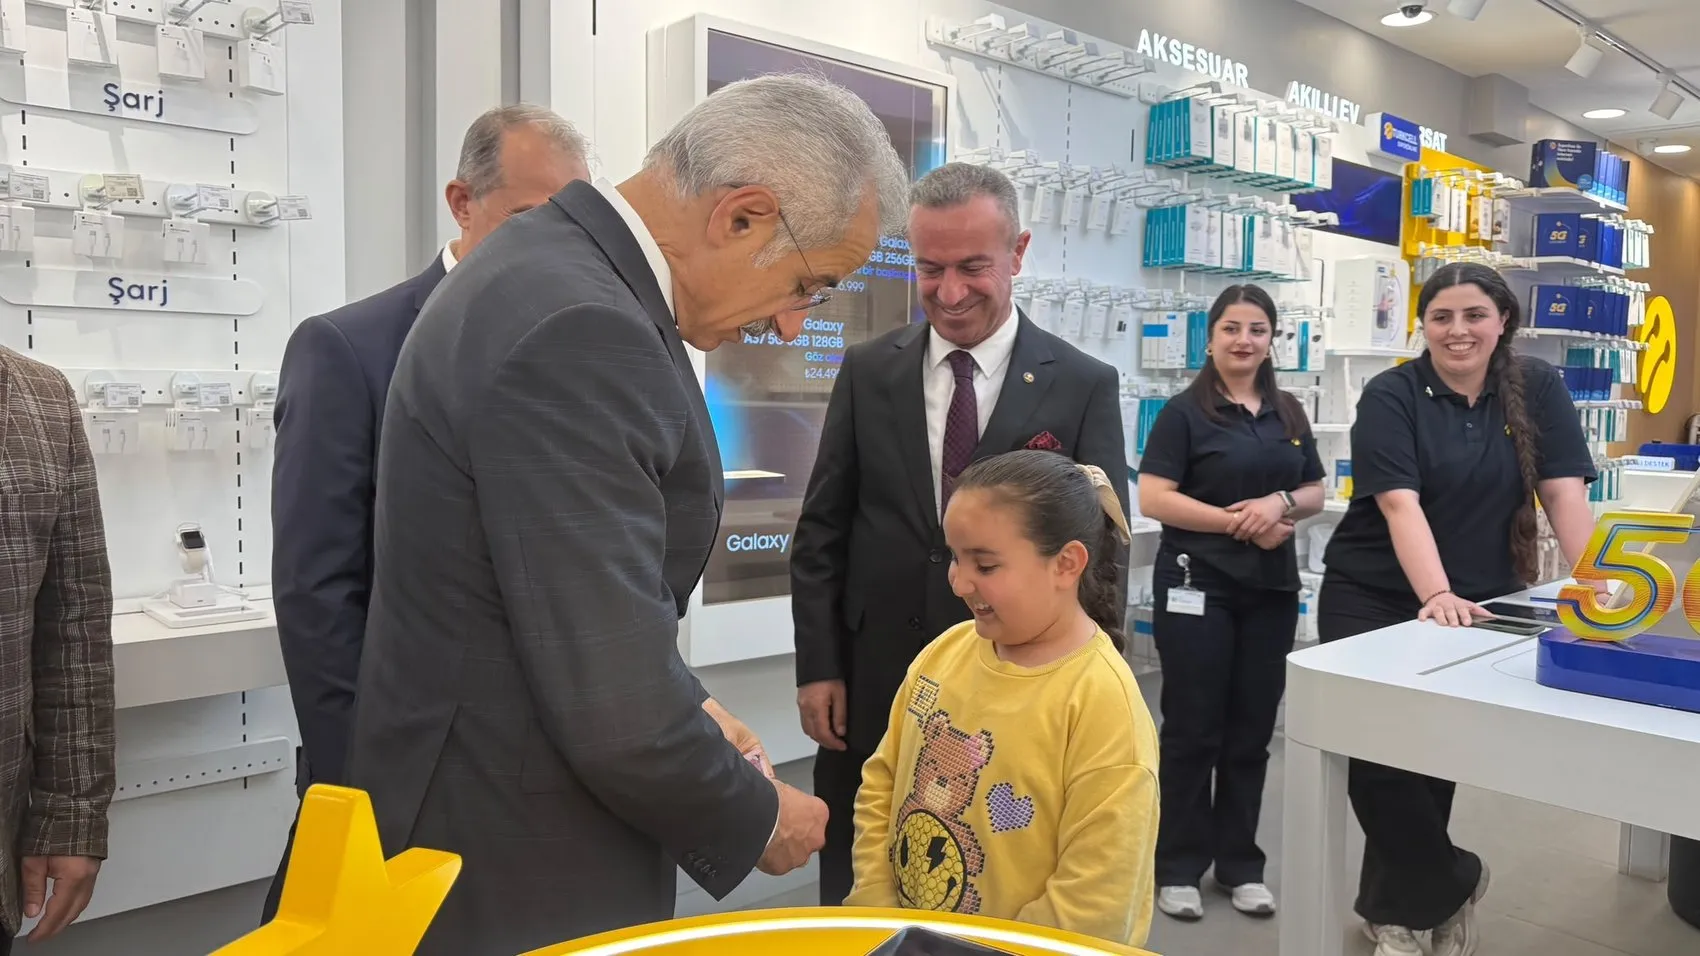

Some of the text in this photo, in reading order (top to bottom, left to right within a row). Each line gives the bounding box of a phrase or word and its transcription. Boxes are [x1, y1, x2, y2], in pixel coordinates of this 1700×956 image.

[1137, 28, 1249, 88] AKSESUAR
[103, 82, 164, 117] Şarj
[1339, 98, 1361, 125] EV
[107, 276, 168, 307] Şarj
[838, 280, 864, 292] 6.999
[803, 318, 844, 335] Galaxy
[787, 334, 810, 347] GB
[811, 335, 844, 348] 128GB
[805, 351, 824, 362] Göz
[805, 367, 840, 379] ₺24.49
[726, 533, 790, 553] Galaxy
